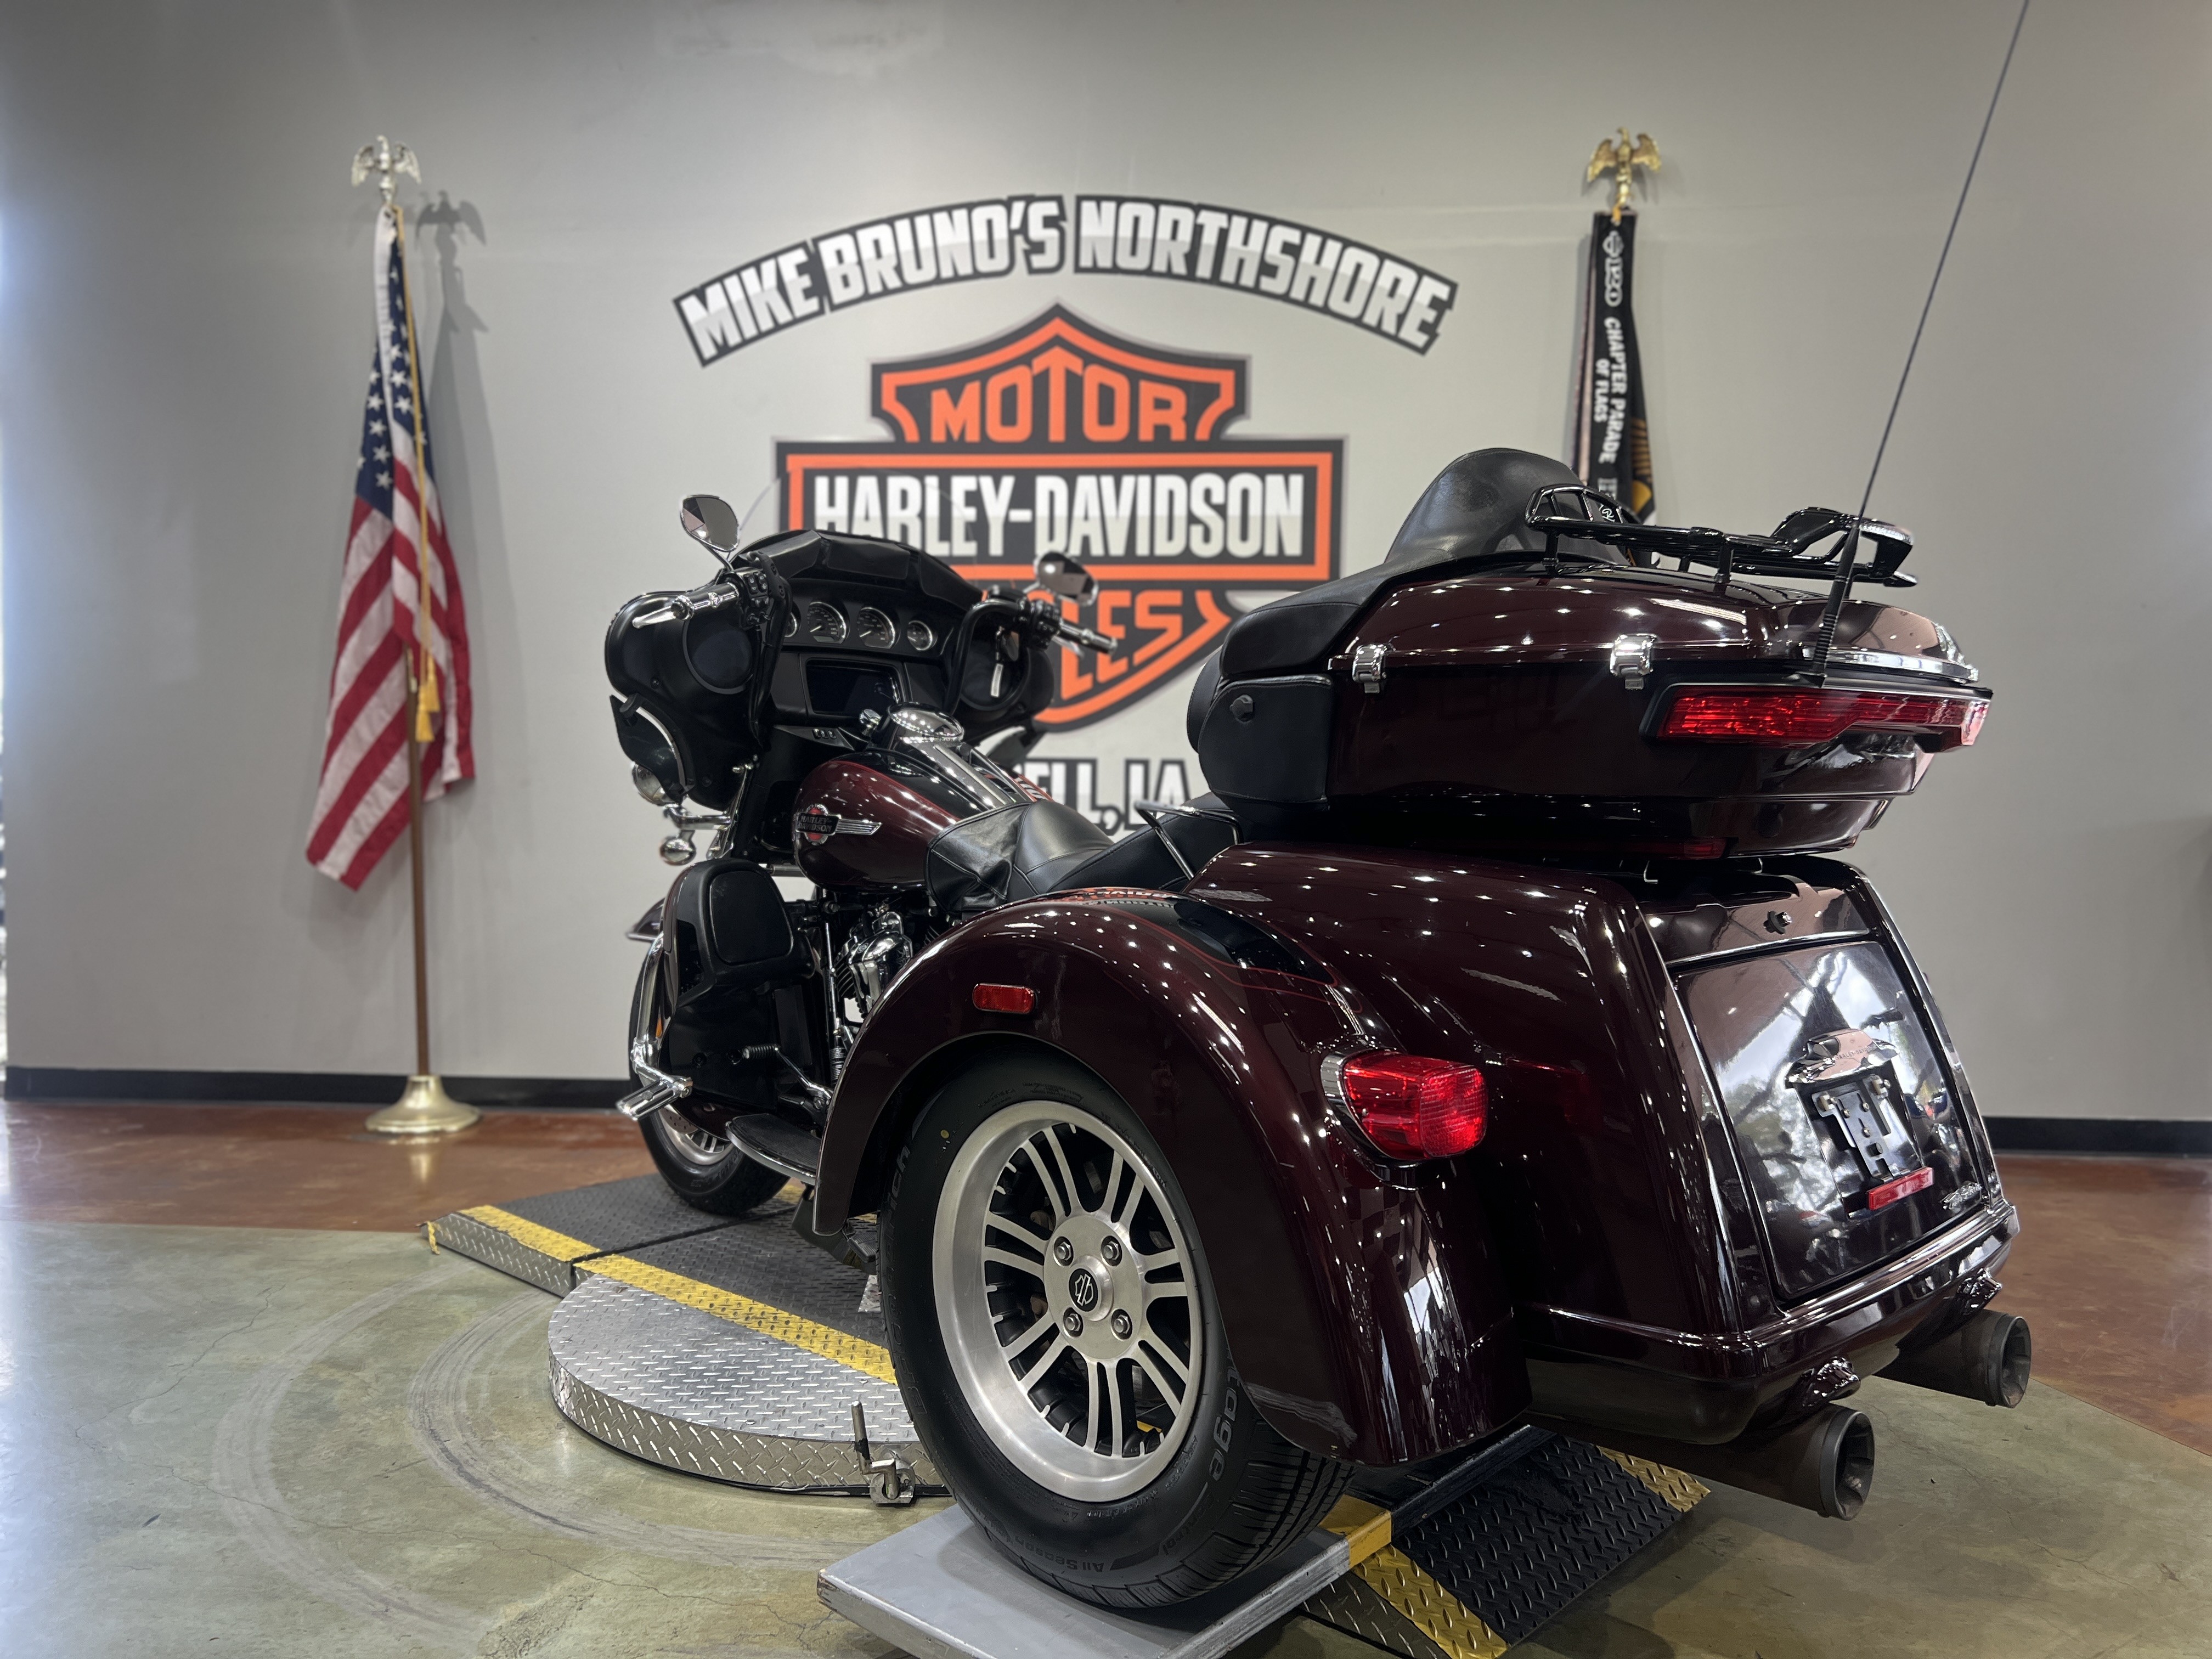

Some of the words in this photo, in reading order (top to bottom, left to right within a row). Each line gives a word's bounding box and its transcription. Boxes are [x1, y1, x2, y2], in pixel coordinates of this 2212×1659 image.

[679, 248, 821, 362] MIKE
[816, 199, 1065, 308] BRUNO'S
[1078, 199, 1453, 349] NORTHSHORE
[929, 345, 1189, 443] MOTOR
[1596, 358, 1610, 377] OF
[1604, 317, 1628, 394] CHAPTER
[1594, 380, 1609, 423] FLAGS
[1599, 399, 1627, 464] PARADE
[813, 473, 1305, 558] HARLEY-DAVIDSON
[798, 822, 832, 833] DAVIDSON
[1207, 1367, 1241, 1482] tage
